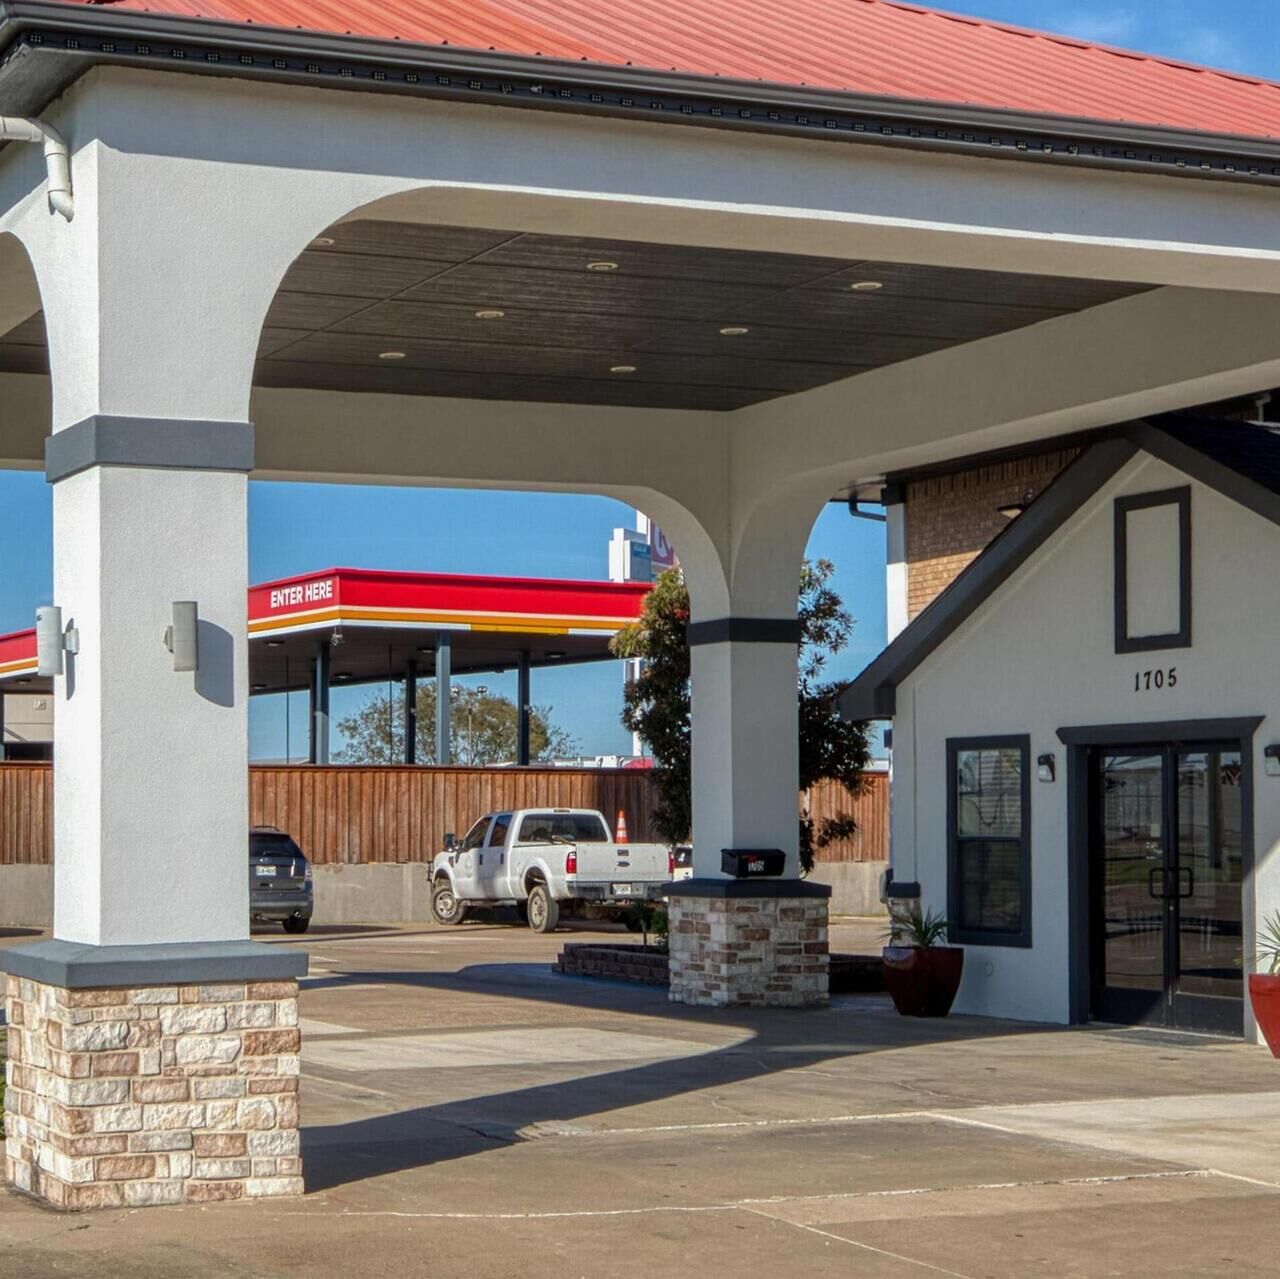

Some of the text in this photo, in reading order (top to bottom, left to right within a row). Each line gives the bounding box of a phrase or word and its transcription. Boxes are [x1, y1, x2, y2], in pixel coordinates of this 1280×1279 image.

[270, 580, 333, 609] ENTER HERE
[1134, 666, 1178, 692] 1705
